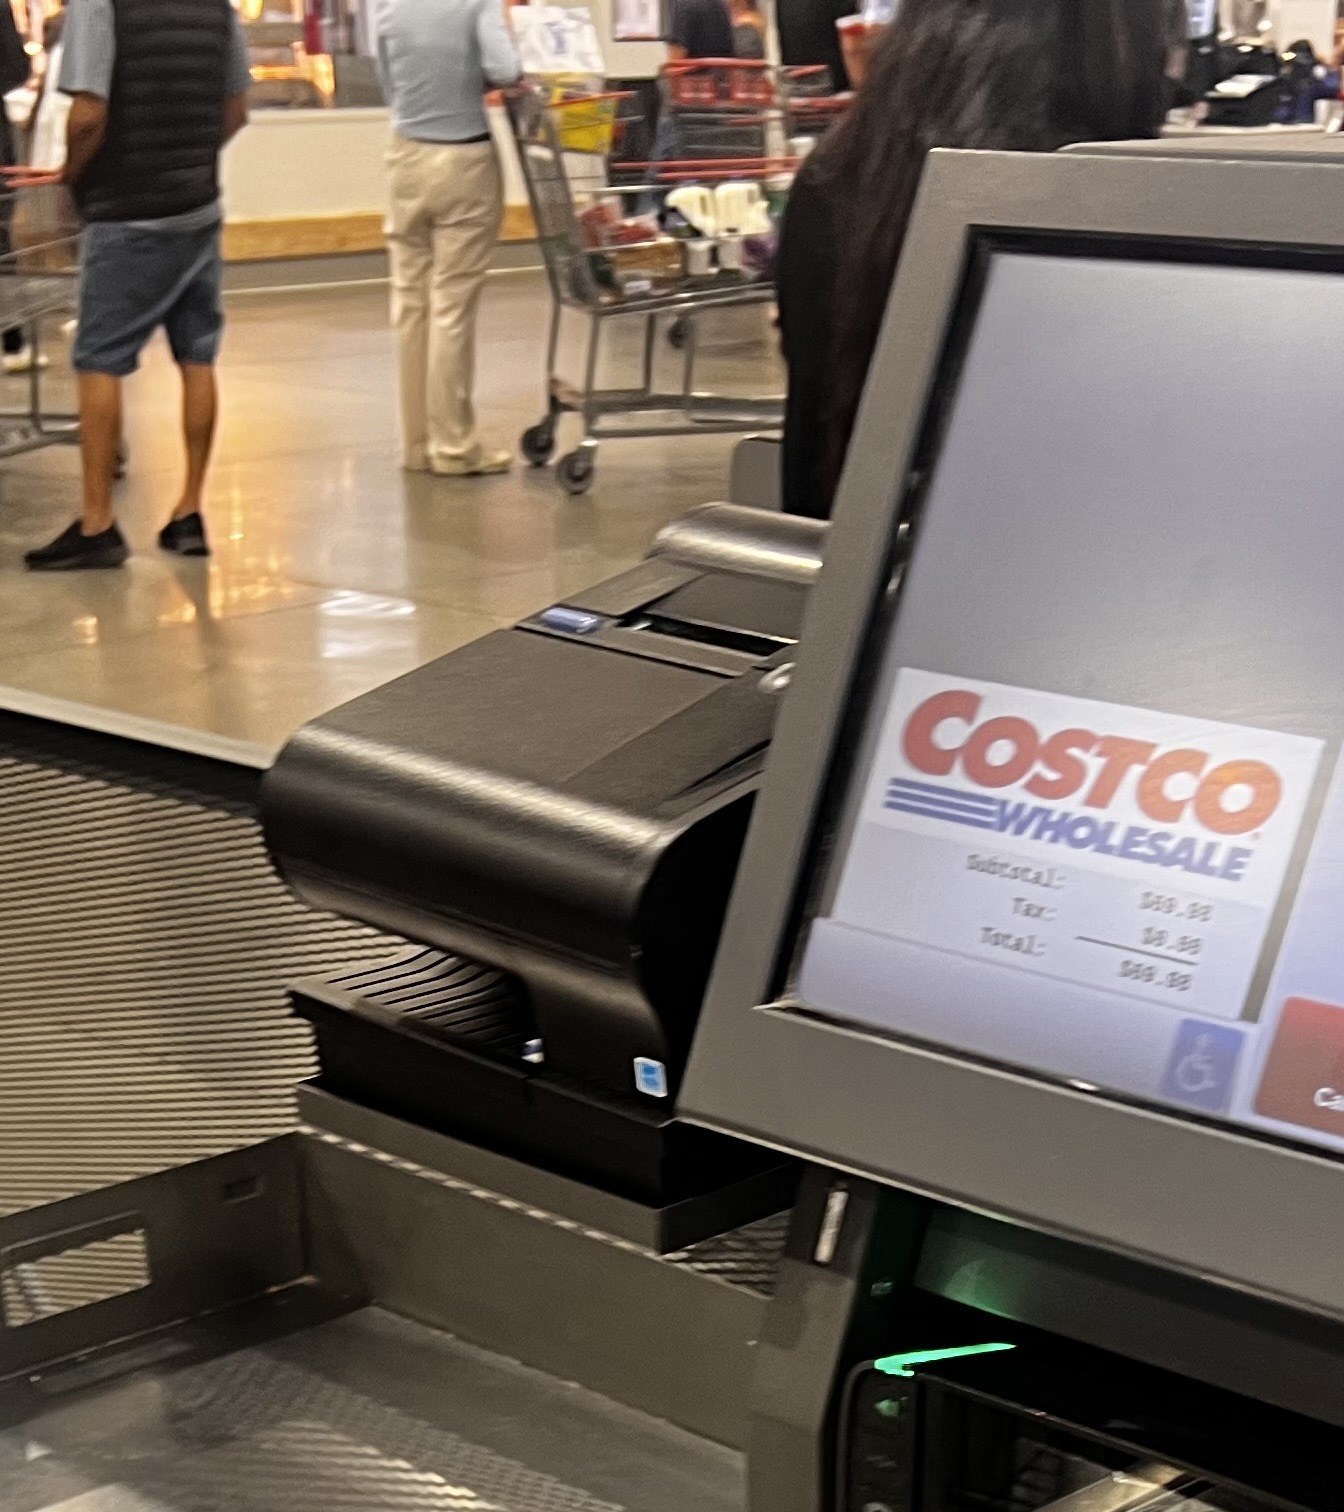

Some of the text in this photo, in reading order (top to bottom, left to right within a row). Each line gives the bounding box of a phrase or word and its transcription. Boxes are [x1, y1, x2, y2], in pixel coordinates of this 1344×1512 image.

[901, 689, 1282, 835] COSTCO
[991, 800, 1254, 881] WHOLESALE
[980, 926, 1046, 957] Total:
